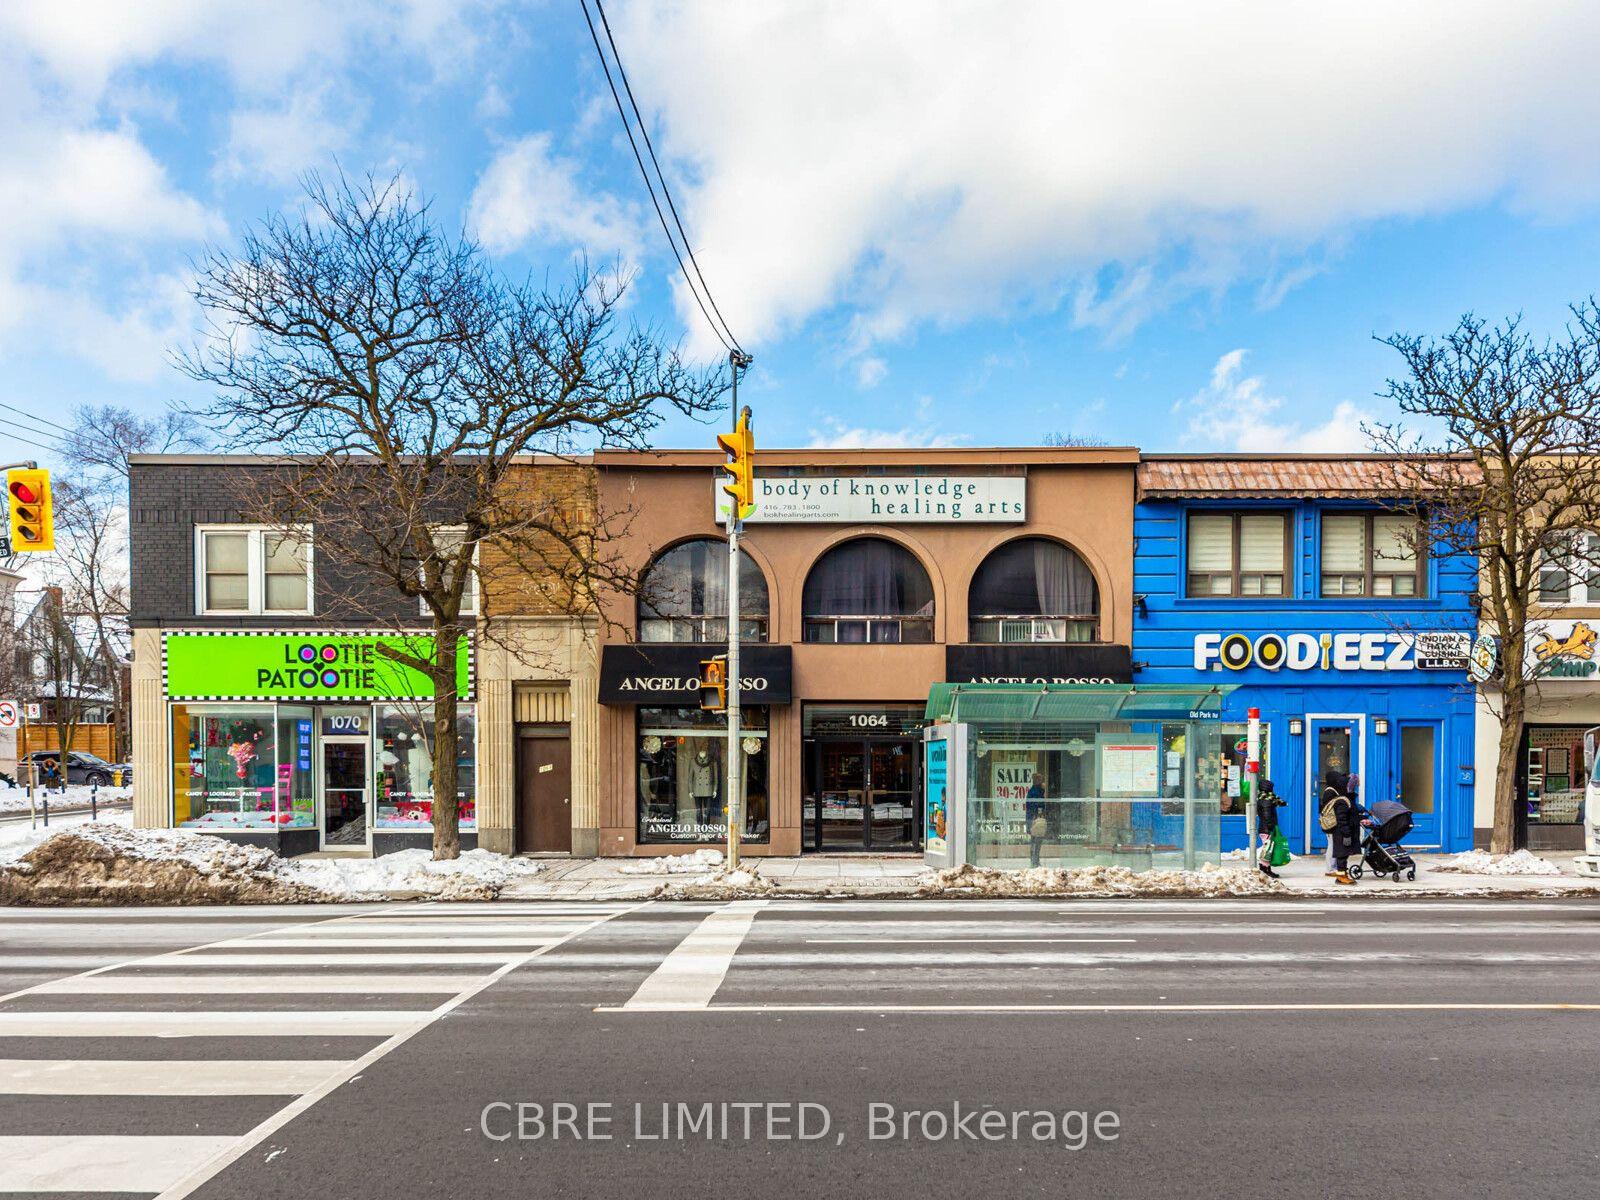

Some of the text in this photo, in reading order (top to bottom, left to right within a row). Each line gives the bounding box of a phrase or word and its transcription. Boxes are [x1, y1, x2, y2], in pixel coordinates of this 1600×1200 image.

[762, 479, 976, 500] body of knowledge
[871, 498, 1022, 518] healing arts
[285, 643, 375, 664] LOOTIE
[1425, 650, 1462, 658] CUISINE
[1427, 643, 1461, 651] HAKKA
[257, 668, 376, 689] PATOOTIE
[618, 677, 700, 691] ANGELO
[330, 715, 362, 729] 1070
[849, 714, 889, 727] 1064
[997, 768, 1032, 784] SALE
[648, 823, 726, 833] ANGELO ROSSO
